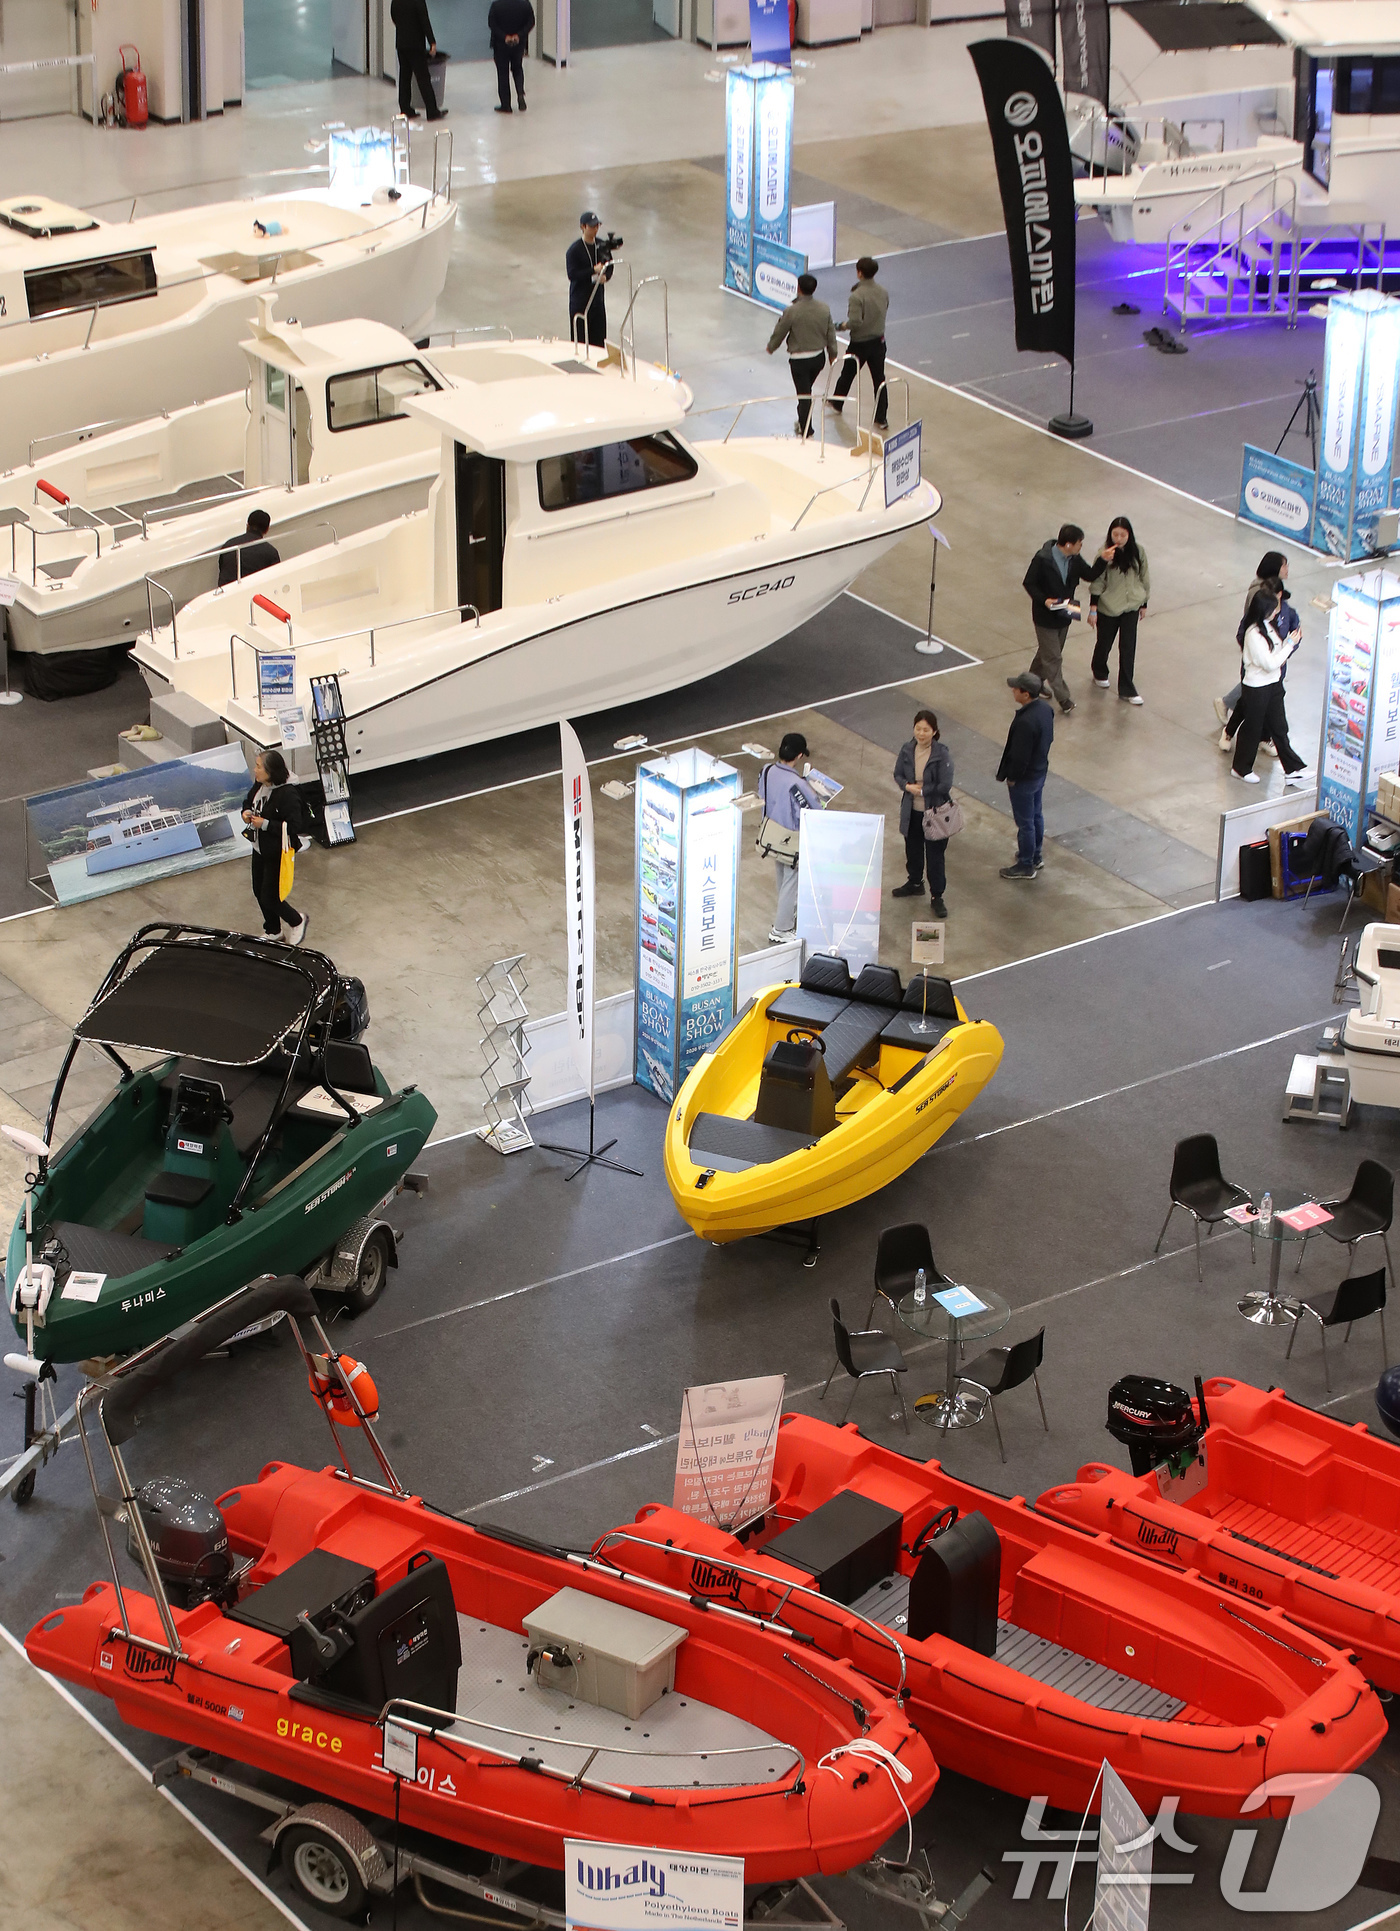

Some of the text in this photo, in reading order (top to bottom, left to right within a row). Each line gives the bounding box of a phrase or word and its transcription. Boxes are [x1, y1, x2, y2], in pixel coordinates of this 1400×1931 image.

[1013, 130, 1055, 315] 오피에스마린
[1320, 480, 1346, 499] BOAT
[1320, 491, 1346, 508] SHOW
[1358, 485, 1384, 501] BOAT
[1259, 491, 1302, 516] 오피에스마린
[1358, 496, 1384, 510] SHOW
[727, 575, 796, 606] SC240
[794, 790, 806, 806] THE
[1324, 796, 1354, 820] BOAT
[1327, 809, 1354, 830] HOW
[700, 854, 717, 952] 씨스톰보트
[645, 990, 668, 1010] BUSAN
[691, 996, 721, 1013] BUSAN
[642, 1001, 671, 1026] BOAT
[686, 1008, 725, 1030] BOAT
[642, 1014, 671, 1038] SHOW
[686, 1019, 725, 1041] SHOW
[304, 1174, 346, 1215] SEA STORM
[121, 1287, 166, 1312] 두나미스
[1112, 1400, 1151, 1419] MERCURY
[1137, 1518, 1178, 1555] Whaly
[691, 1558, 742, 1602] Whaly
[1242, 1580, 1263, 1600] 380
[125, 1643, 178, 1685] Whaly
[204, 1700, 227, 1716] 500R
[276, 1717, 343, 1753] grace
[577, 1857, 665, 1898] Whaly
[669, 1863, 709, 1875] 태양마린
[644, 1900, 739, 1918] Polyethylene Boats
[644, 1910, 662, 1918] Made
[684, 1914, 722, 1924] Netherlands
